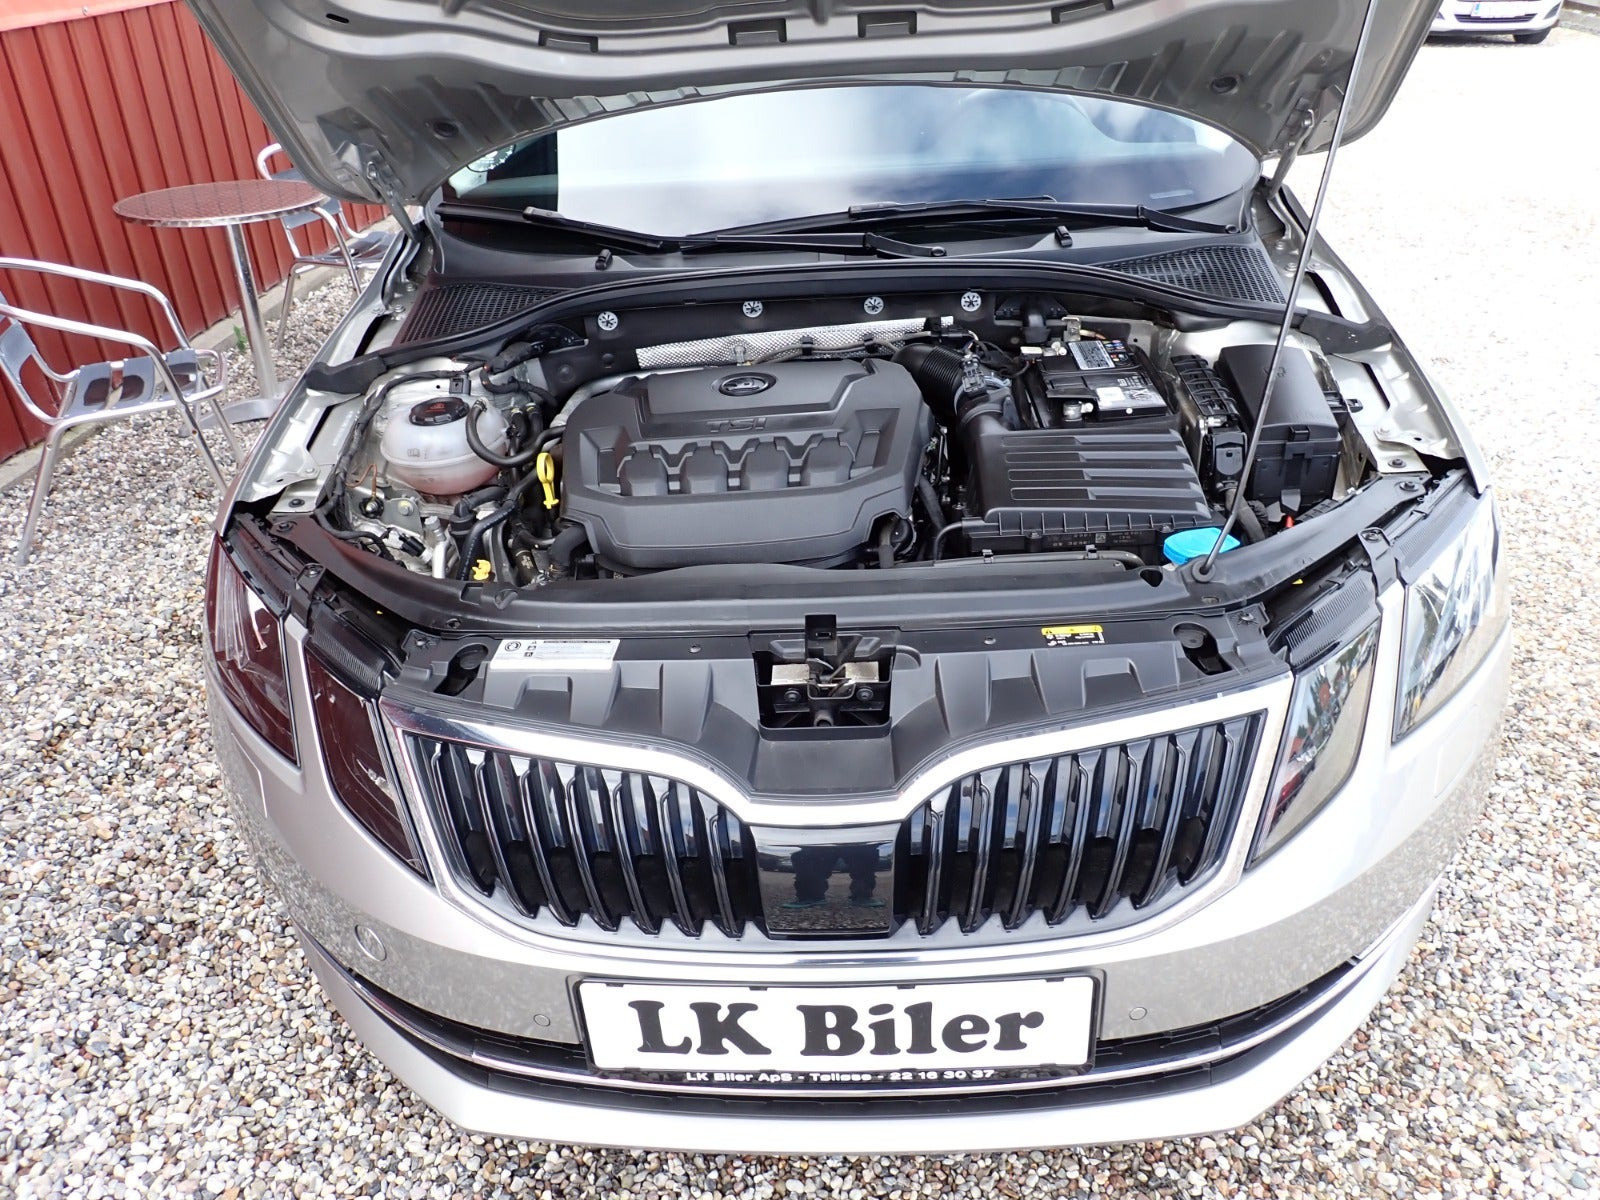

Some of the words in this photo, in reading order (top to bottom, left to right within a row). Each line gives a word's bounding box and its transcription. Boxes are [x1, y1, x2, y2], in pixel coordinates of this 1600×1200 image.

[628, 1000, 772, 1055] LK
[796, 1001, 1045, 1057] Biler
[685, 1072, 709, 1081] LK
[713, 1072, 753, 1082] Biler
[757, 1072, 793, 1083] ApS
[889, 1071, 913, 1081] 22
[943, 1070, 967, 1080] 30
[971, 1069, 995, 1079] 37
